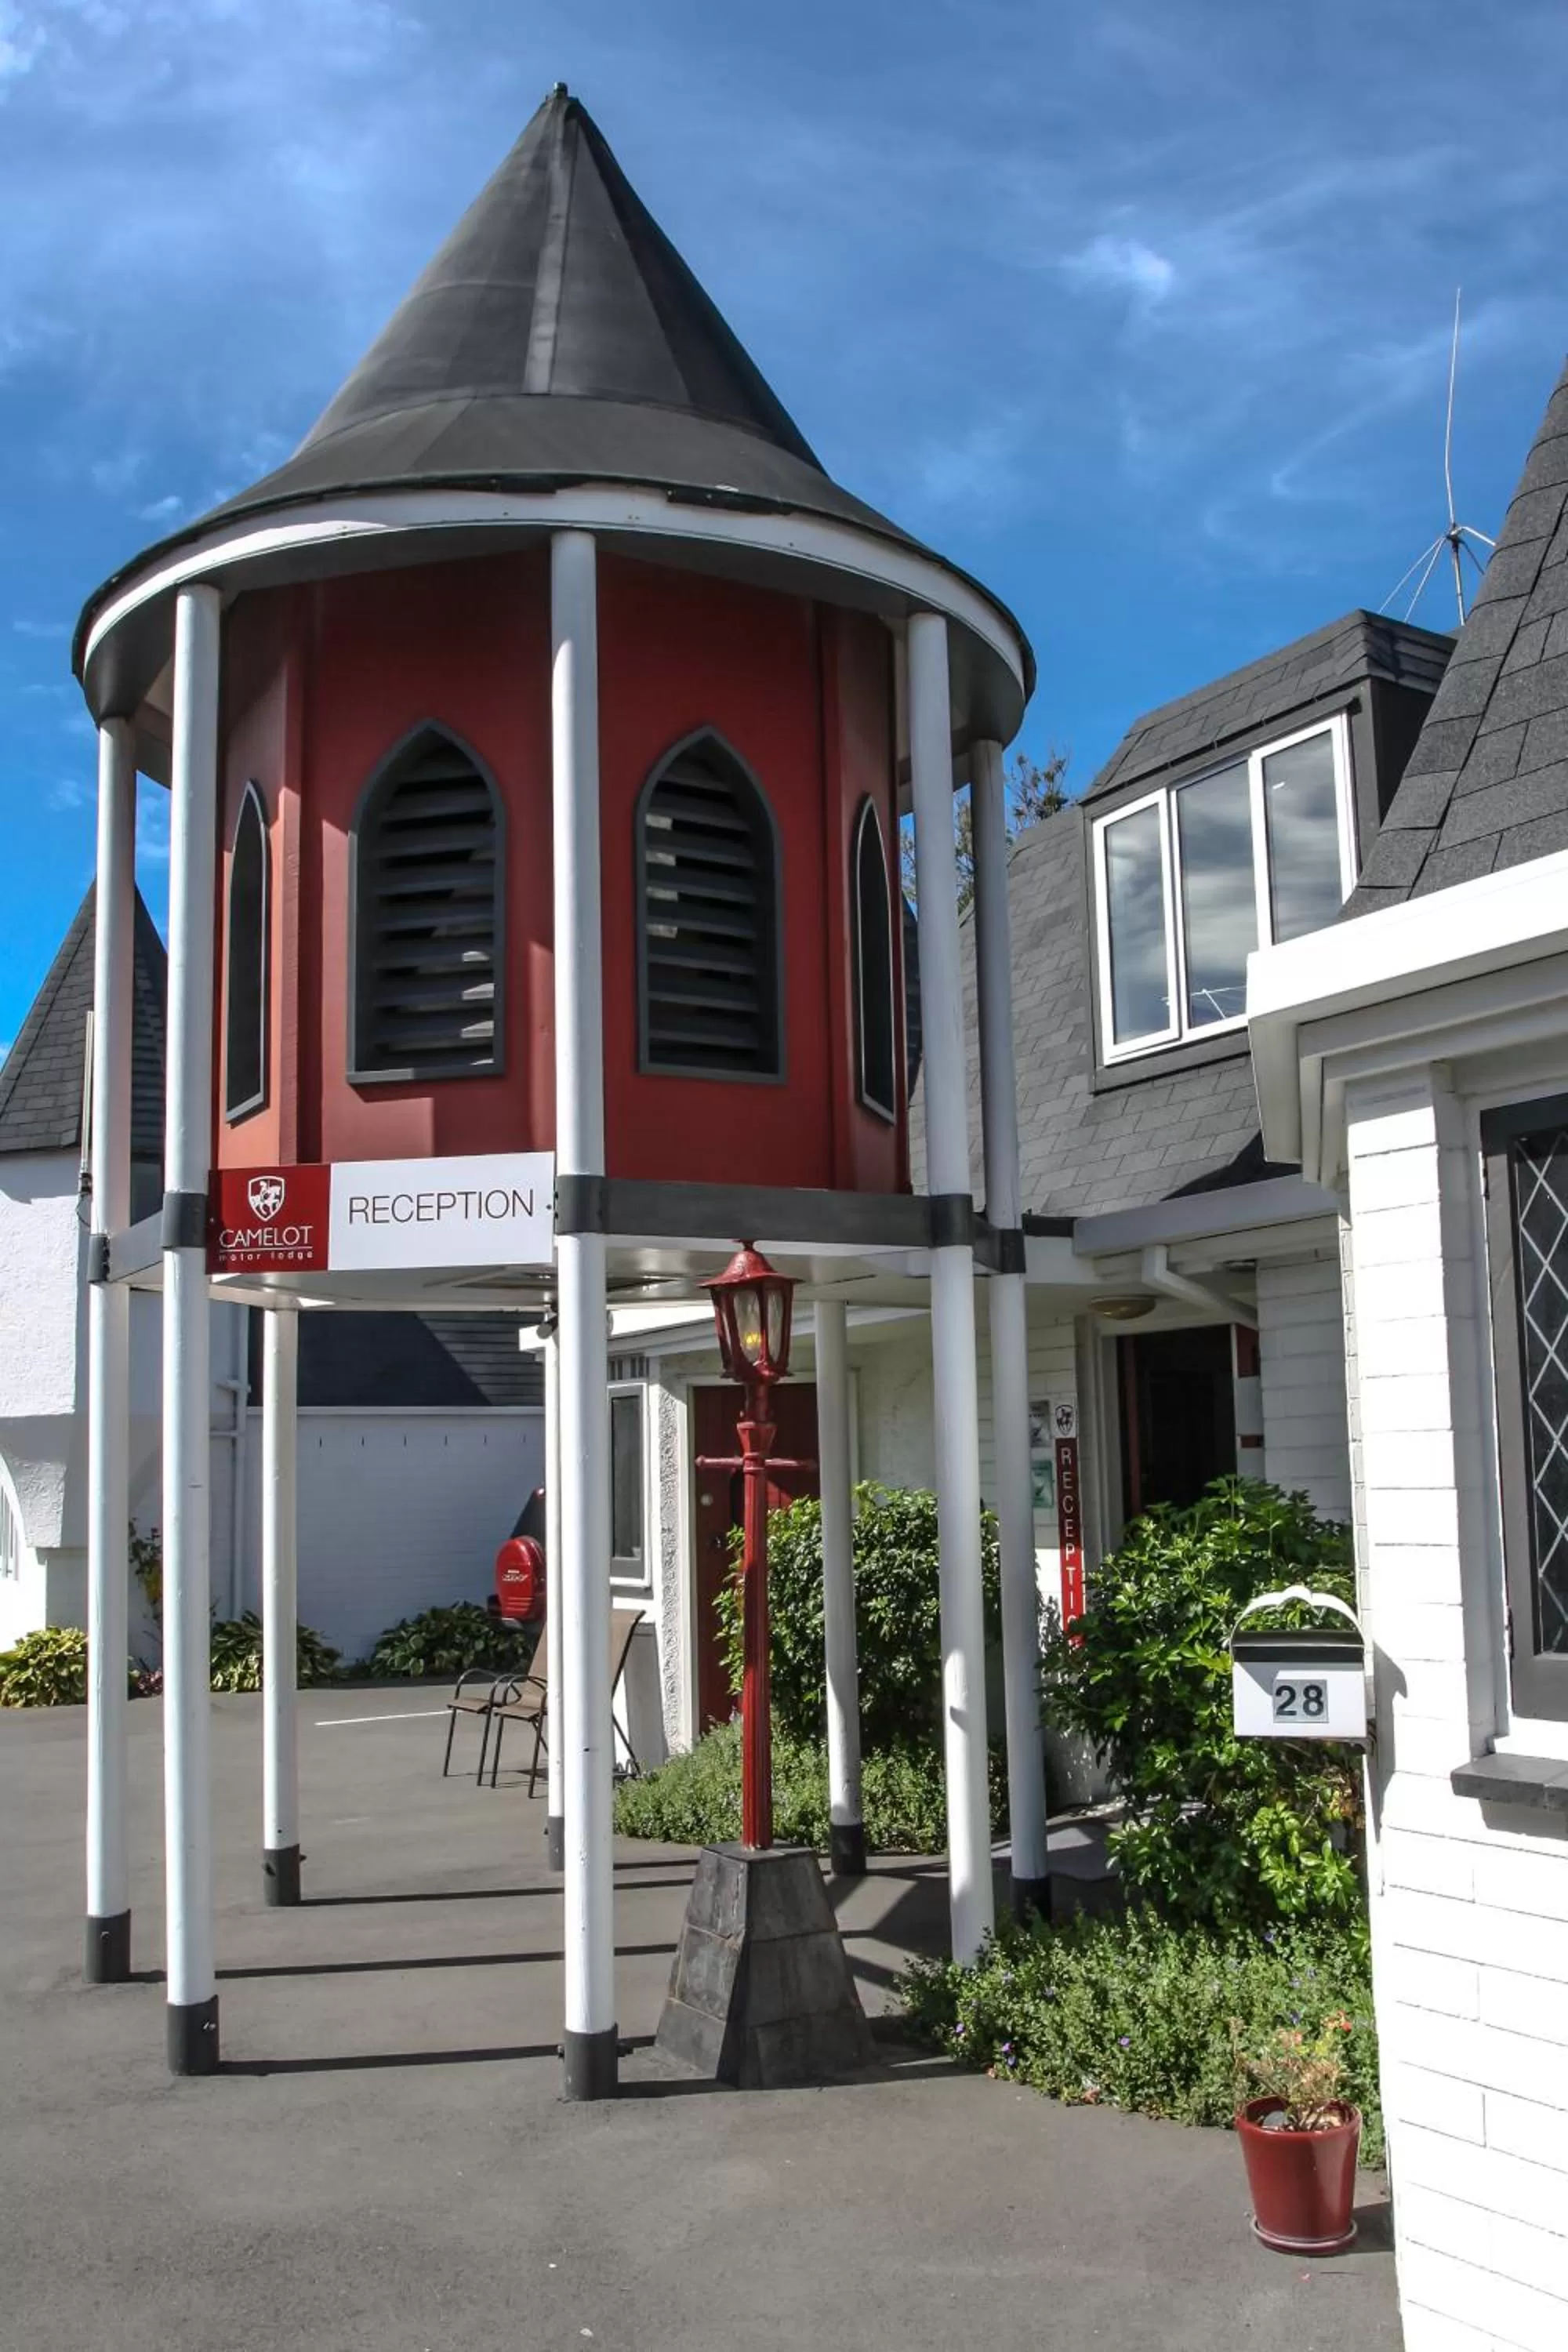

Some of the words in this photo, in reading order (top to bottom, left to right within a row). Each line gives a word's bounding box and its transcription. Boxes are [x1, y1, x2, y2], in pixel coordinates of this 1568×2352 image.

[349, 1189, 533, 1225] RECEPTION
[219, 1225, 314, 1247] CAMELOT
[1275, 1684, 1325, 1717] 28
